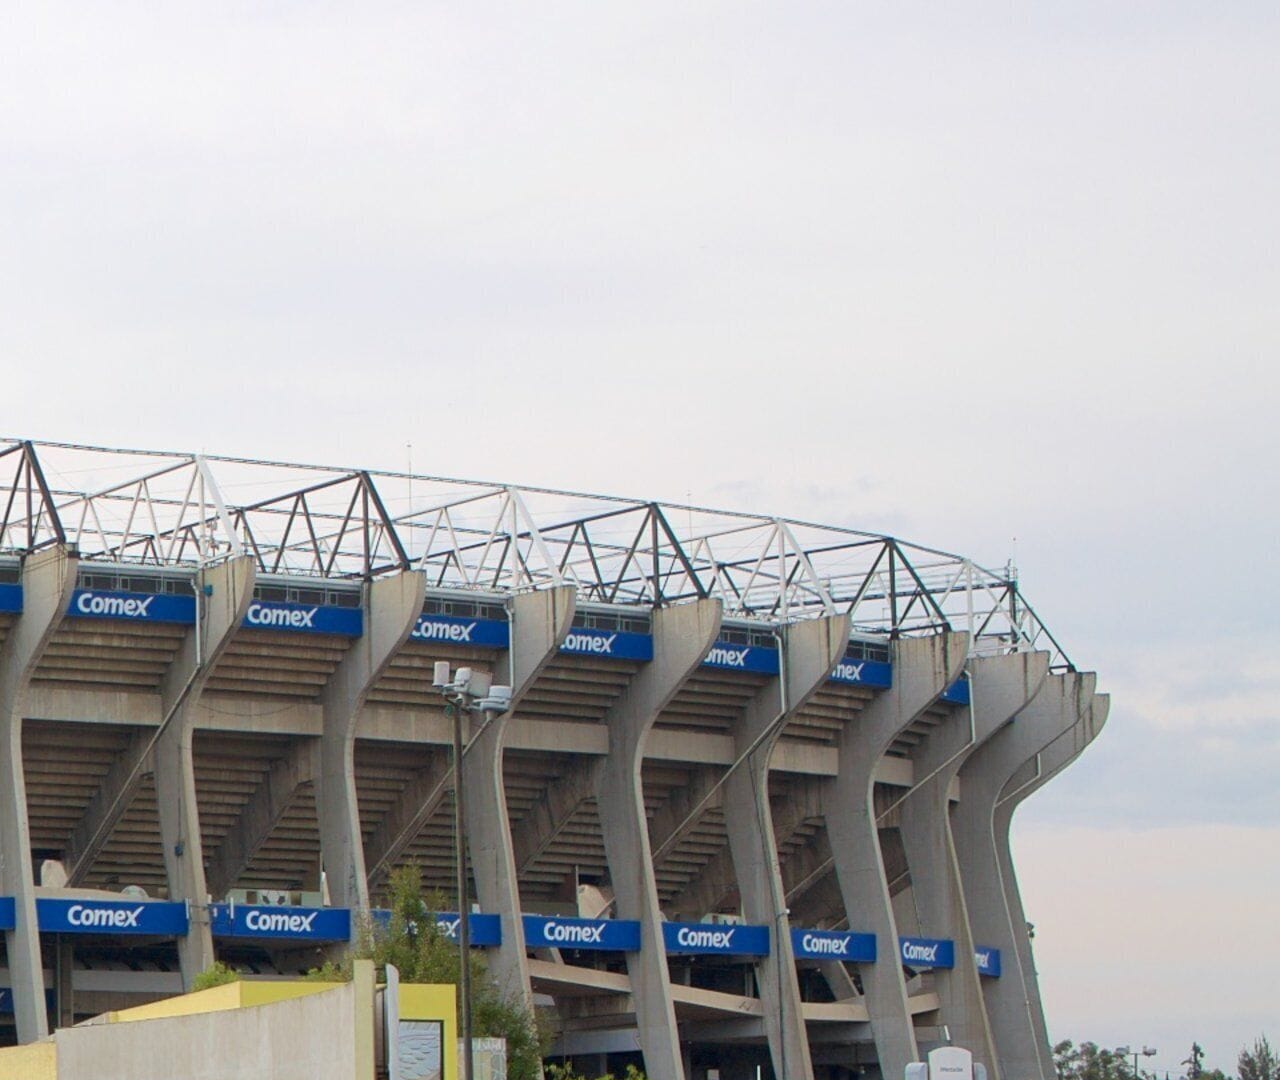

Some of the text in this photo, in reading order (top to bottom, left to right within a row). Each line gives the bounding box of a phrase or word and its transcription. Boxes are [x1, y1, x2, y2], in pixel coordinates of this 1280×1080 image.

[77, 592, 154, 617] Comex
[247, 604, 319, 628] Comex
[559, 634, 617, 654] omex
[703, 648, 751, 667] omex
[831, 662, 865, 682] mex
[67, 904, 145, 928] Comex
[246, 910, 319, 932] Comex
[544, 922, 607, 944] Comex
[678, 928, 735, 949] Comex
[802, 933, 851, 955] Comex
[902, 941, 938, 962] Comex
